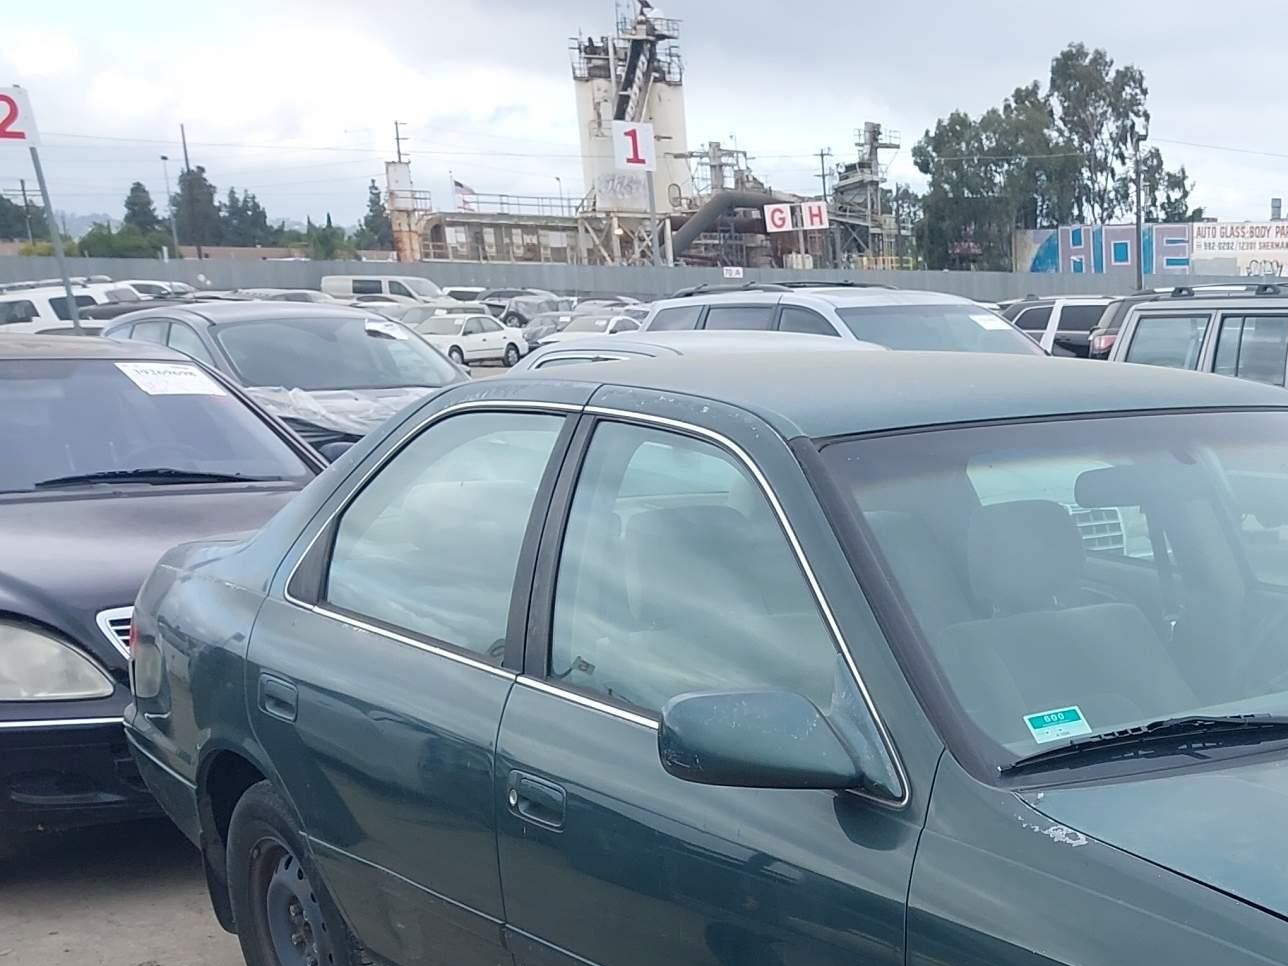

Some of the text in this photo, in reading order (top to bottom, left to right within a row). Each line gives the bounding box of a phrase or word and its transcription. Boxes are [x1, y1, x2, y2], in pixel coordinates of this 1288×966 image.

[0, 94, 26, 139] 2
[624, 129, 646, 164] 1
[771, 208, 786, 229] G
[808, 206, 823, 227] H
[1196, 226, 1217, 238] AUTO
